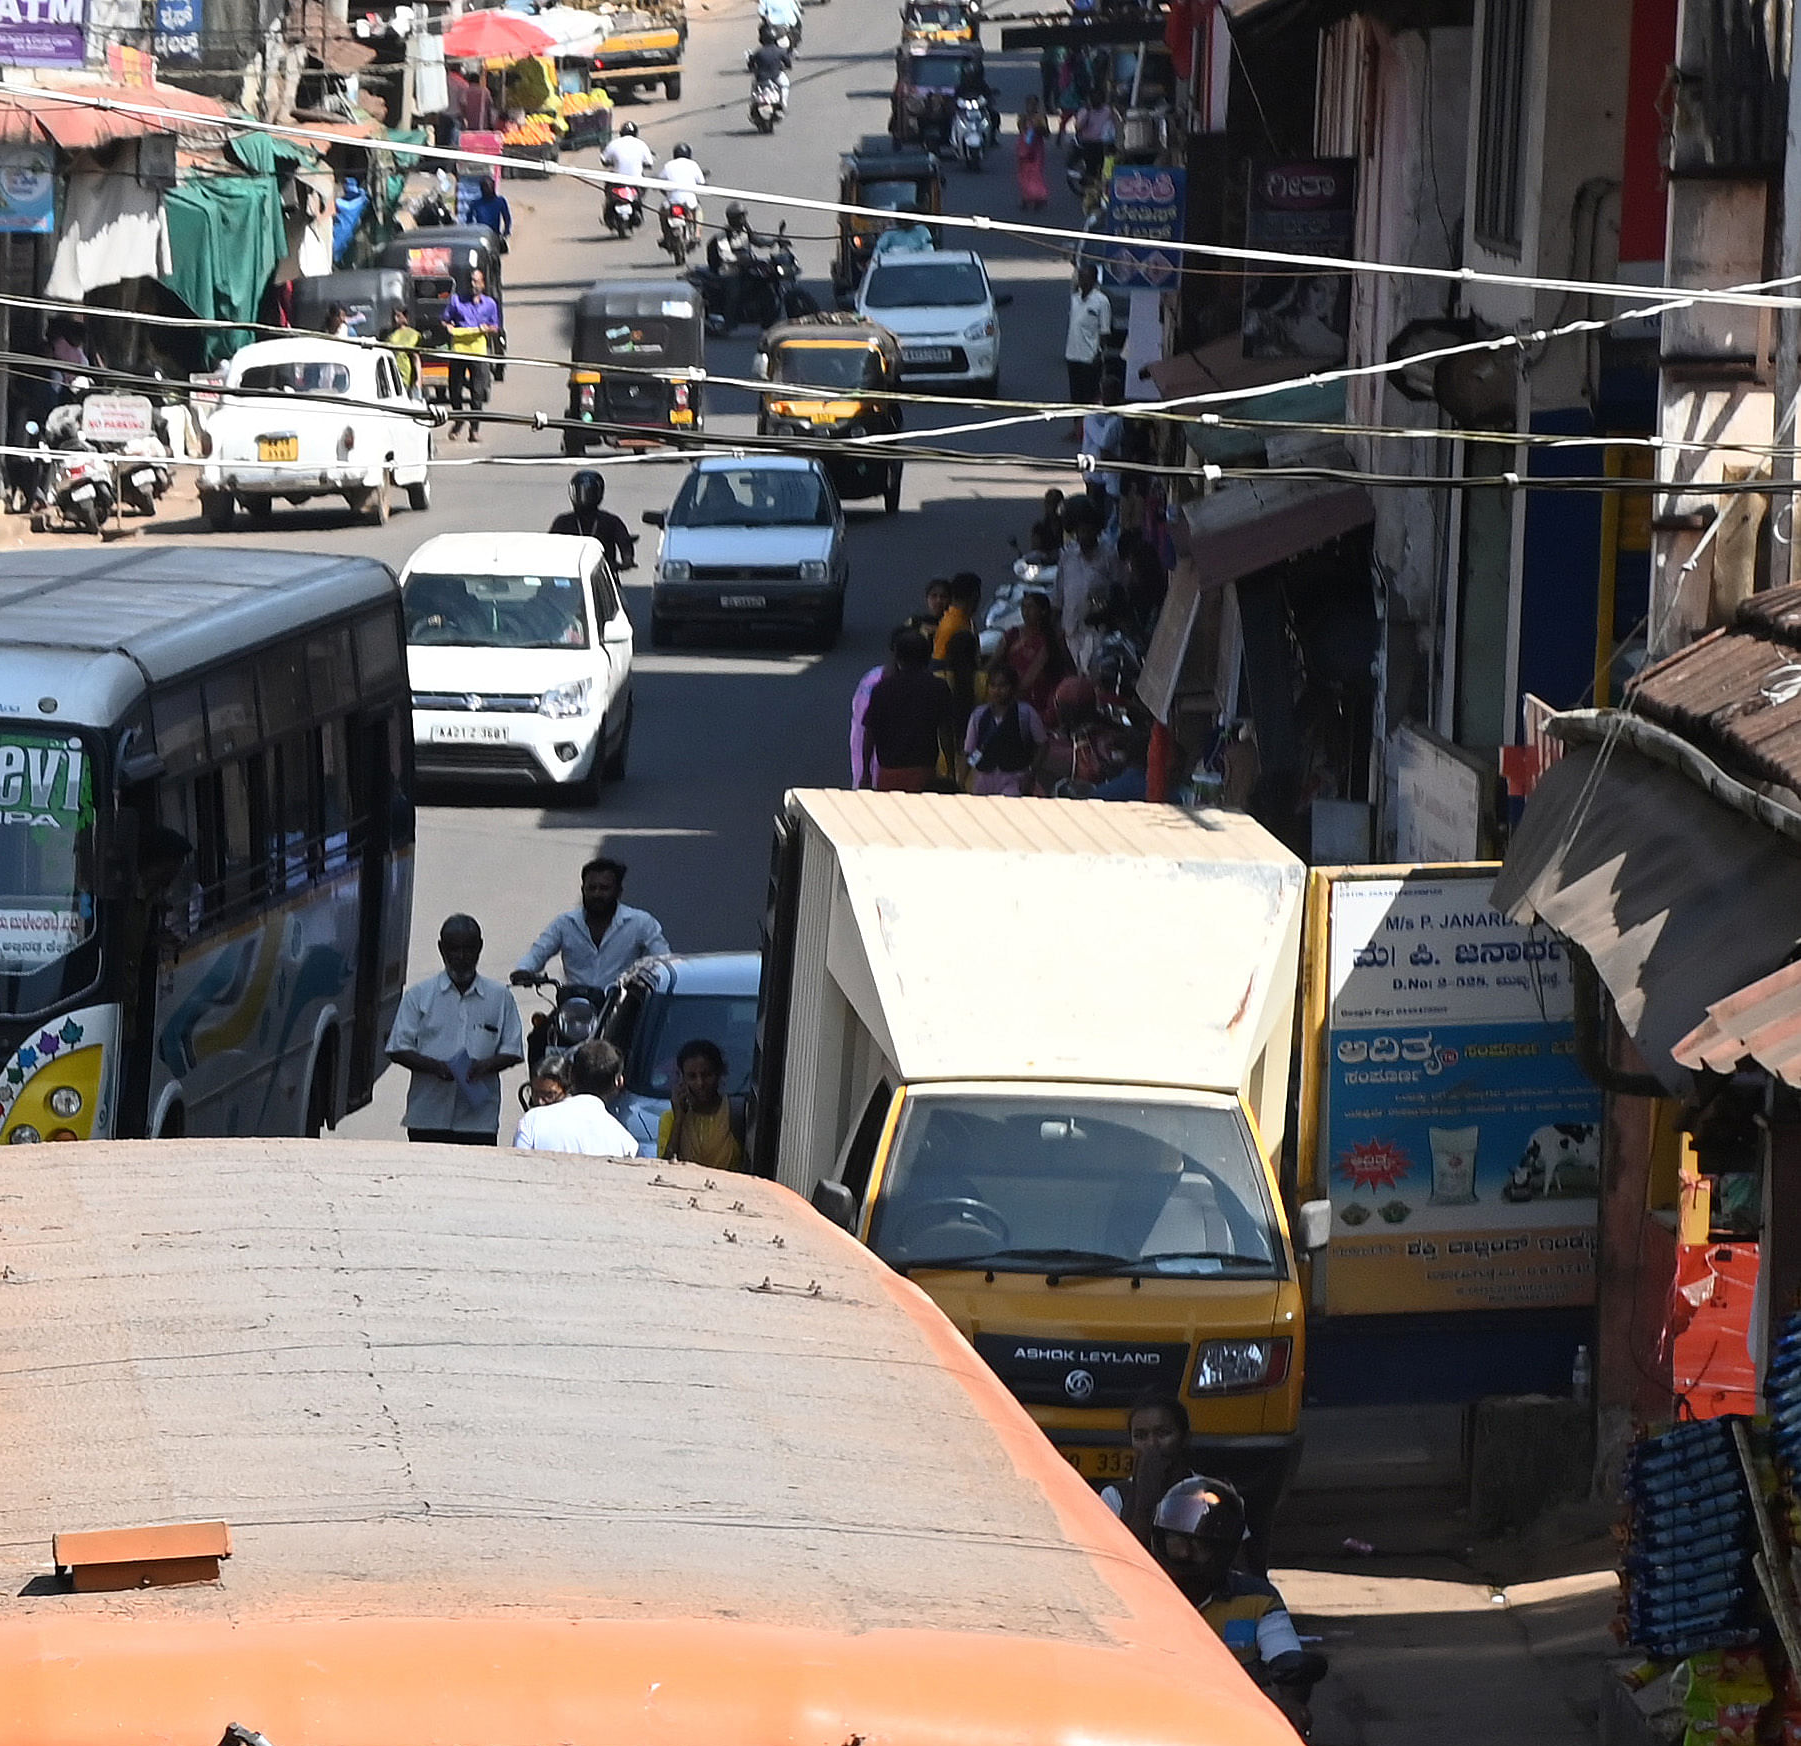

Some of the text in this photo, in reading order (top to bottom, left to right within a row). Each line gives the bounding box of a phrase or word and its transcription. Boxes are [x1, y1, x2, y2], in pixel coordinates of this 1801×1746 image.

[1385, 914, 1415, 932] M/s
[1420, 913, 1435, 930] P.
[1337, 1031, 1443, 1076] ಆದಿತ್ಯ
[1013, 1346, 1162, 1365] ASHOK LEYLAND
